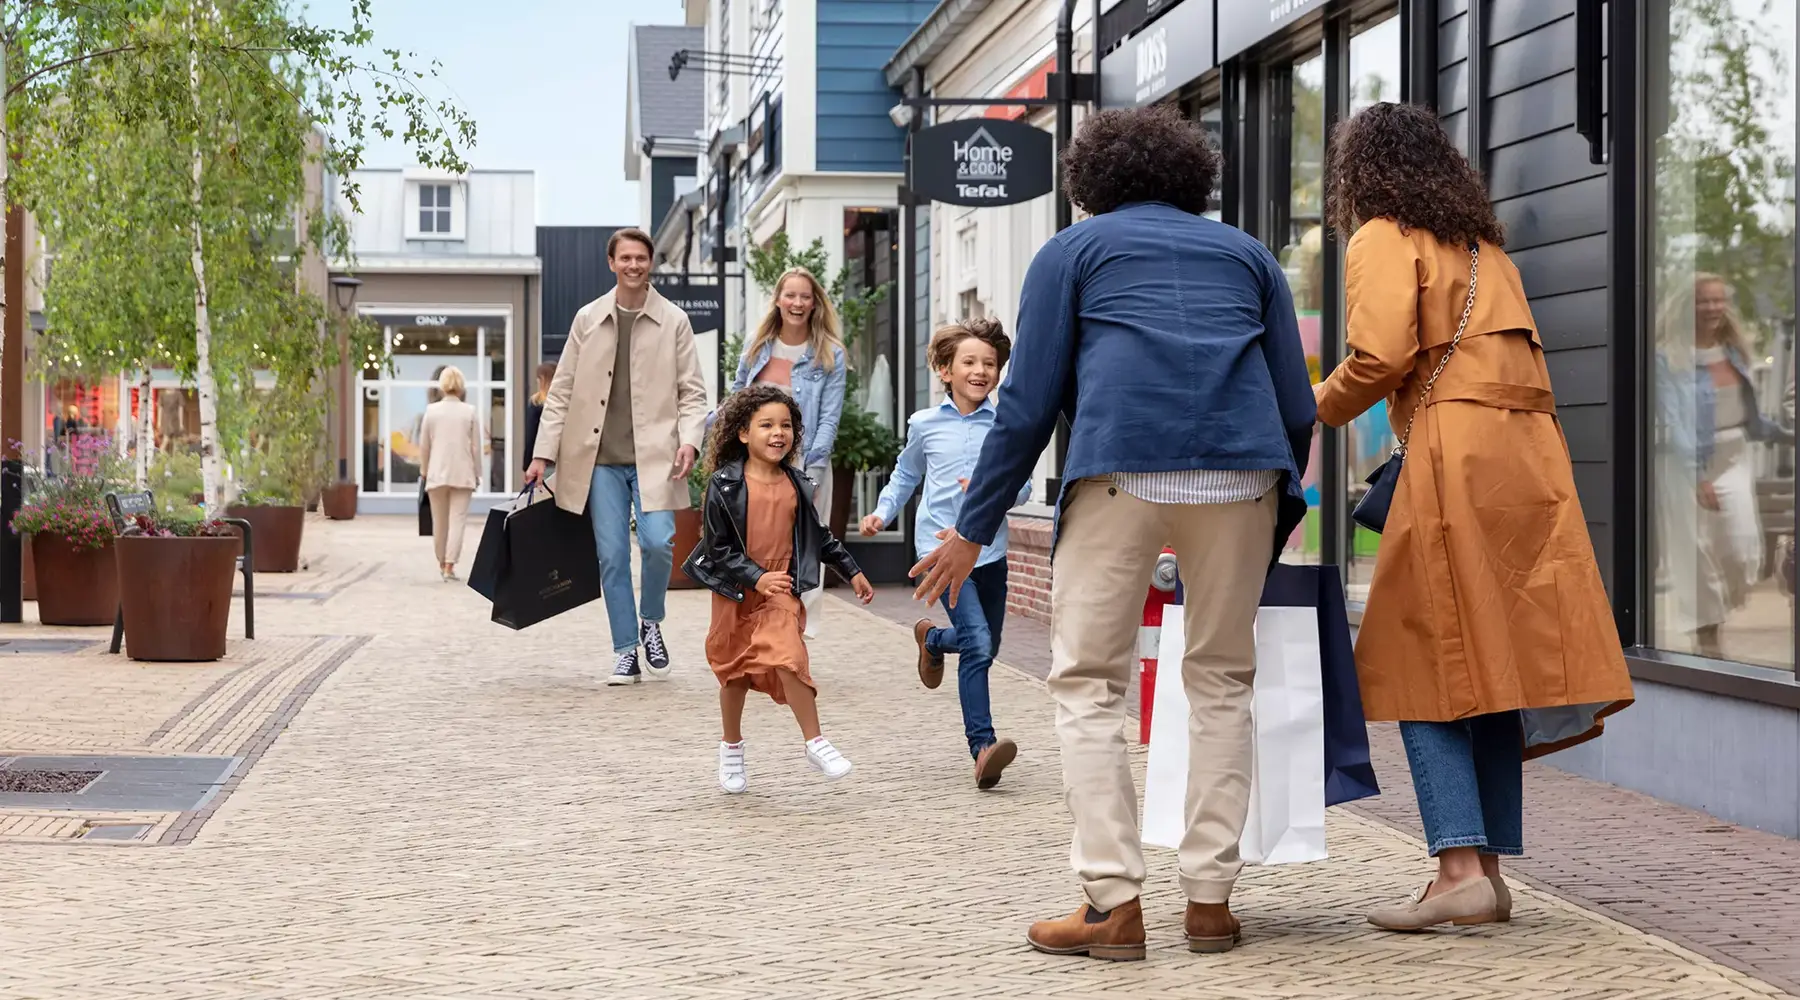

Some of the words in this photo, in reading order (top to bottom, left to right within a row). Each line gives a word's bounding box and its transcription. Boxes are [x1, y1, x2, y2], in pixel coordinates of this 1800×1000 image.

[953, 140, 1013, 163] Home
[955, 184, 1008, 198] Tefal
[692, 300, 719, 310] SODA
[415, 315, 448, 327] ONLY
